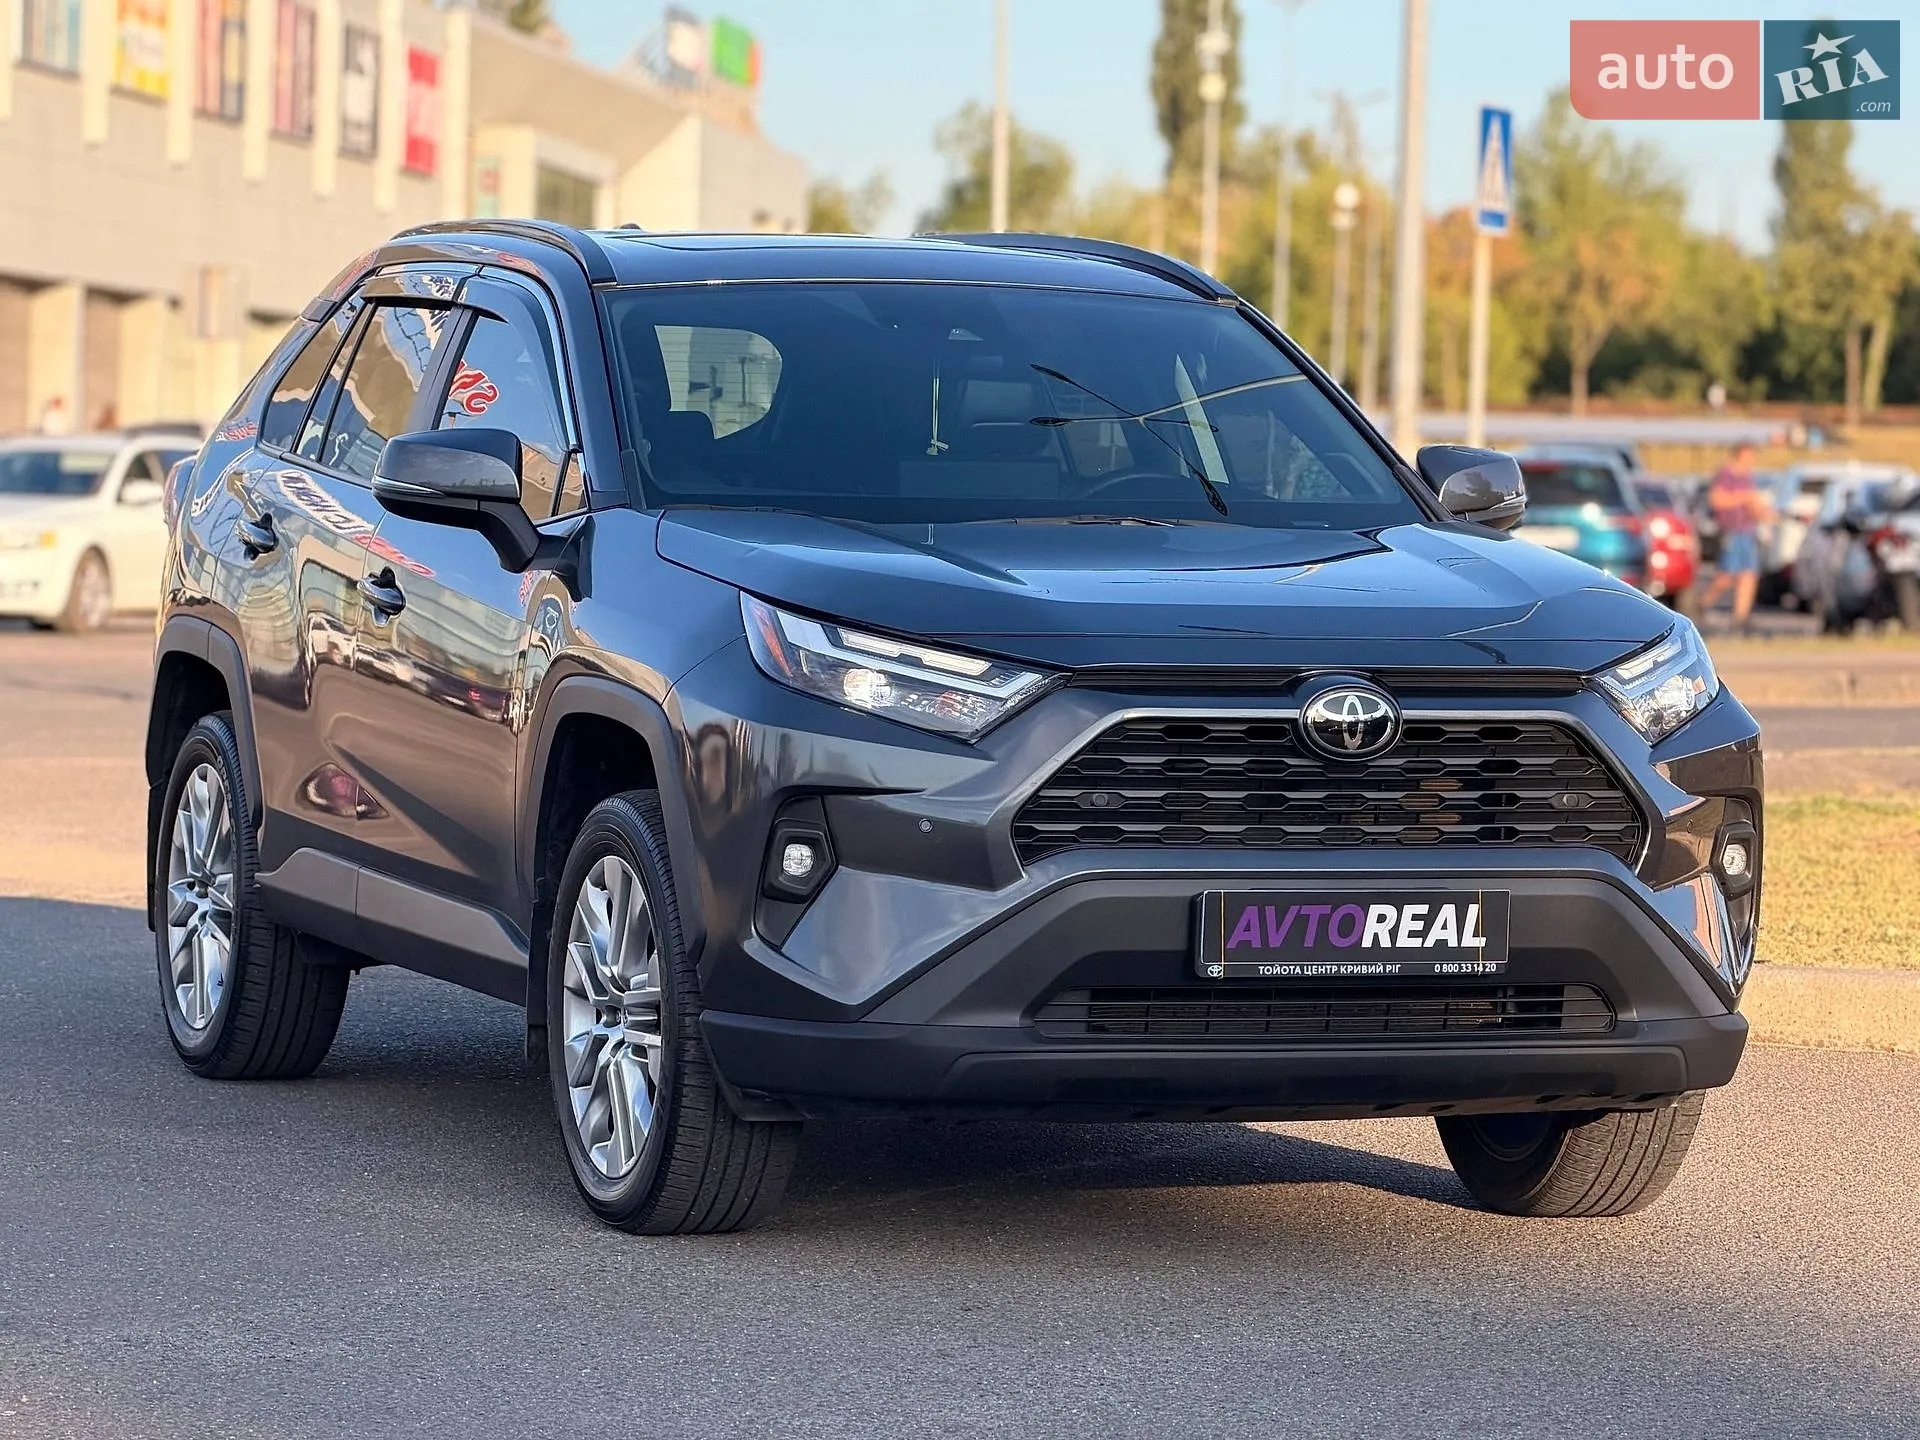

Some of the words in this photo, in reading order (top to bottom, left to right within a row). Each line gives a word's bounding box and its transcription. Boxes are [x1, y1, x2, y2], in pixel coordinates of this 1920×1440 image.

[1226, 904, 1487, 948] AVTOREAL
[1258, 964, 1302, 975] ТОЙОТА
[1303, 965, 1338, 976] ЦЕНТР
[1340, 963, 1384, 974] КРИВИЙ
[1386, 964, 1401, 974] РІГ
[1434, 963, 1441, 973] 0
[1442, 963, 1459, 973] 800
[1460, 963, 1472, 973] 33
[1485, 962, 1497, 972] 20
